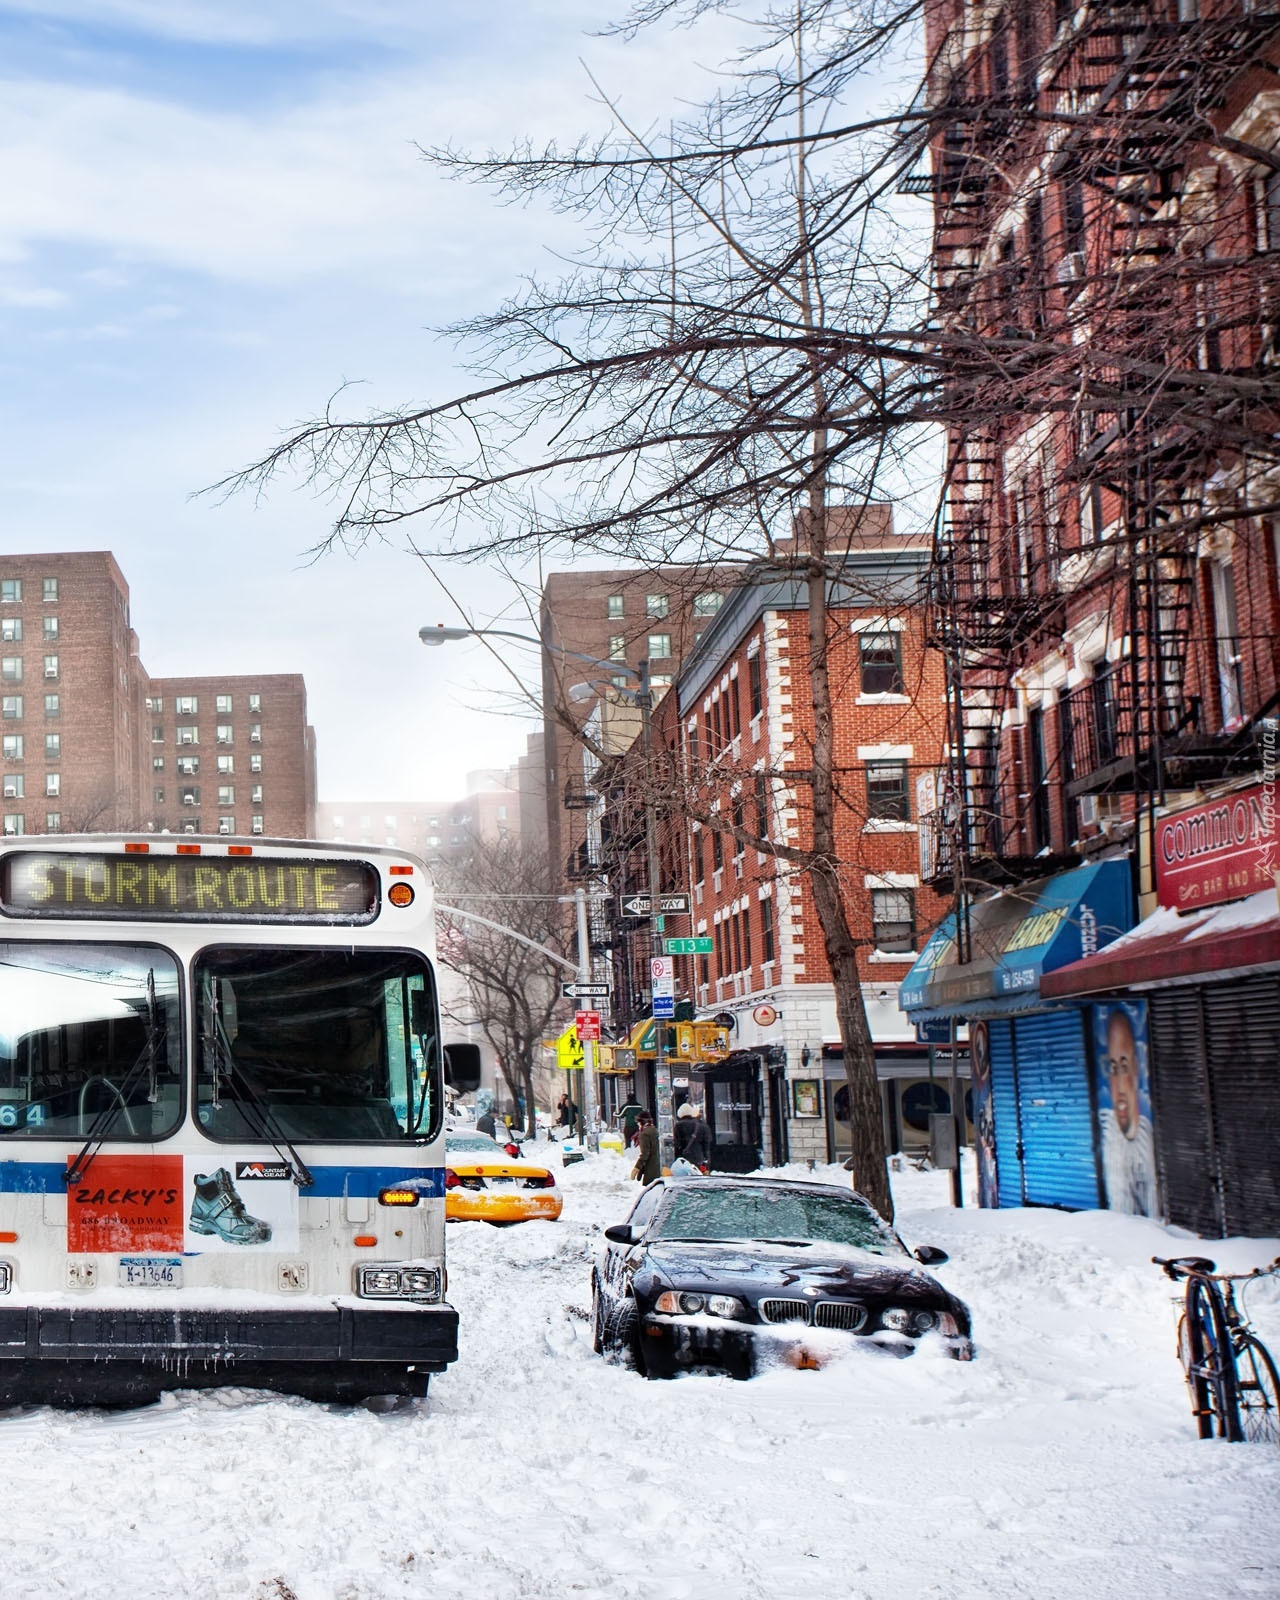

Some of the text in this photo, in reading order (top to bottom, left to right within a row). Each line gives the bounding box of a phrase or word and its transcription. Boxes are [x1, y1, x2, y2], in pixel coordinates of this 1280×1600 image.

[27, 859, 340, 909] STORM ROUTE
[631, 900, 681, 910] ONE WAY
[668, 941, 677, 953] E
[681, 940, 697, 952] 13
[75, 1188, 178, 1207] ZACKY'S
[81, 1216, 170, 1225] 686 BROADWAY
